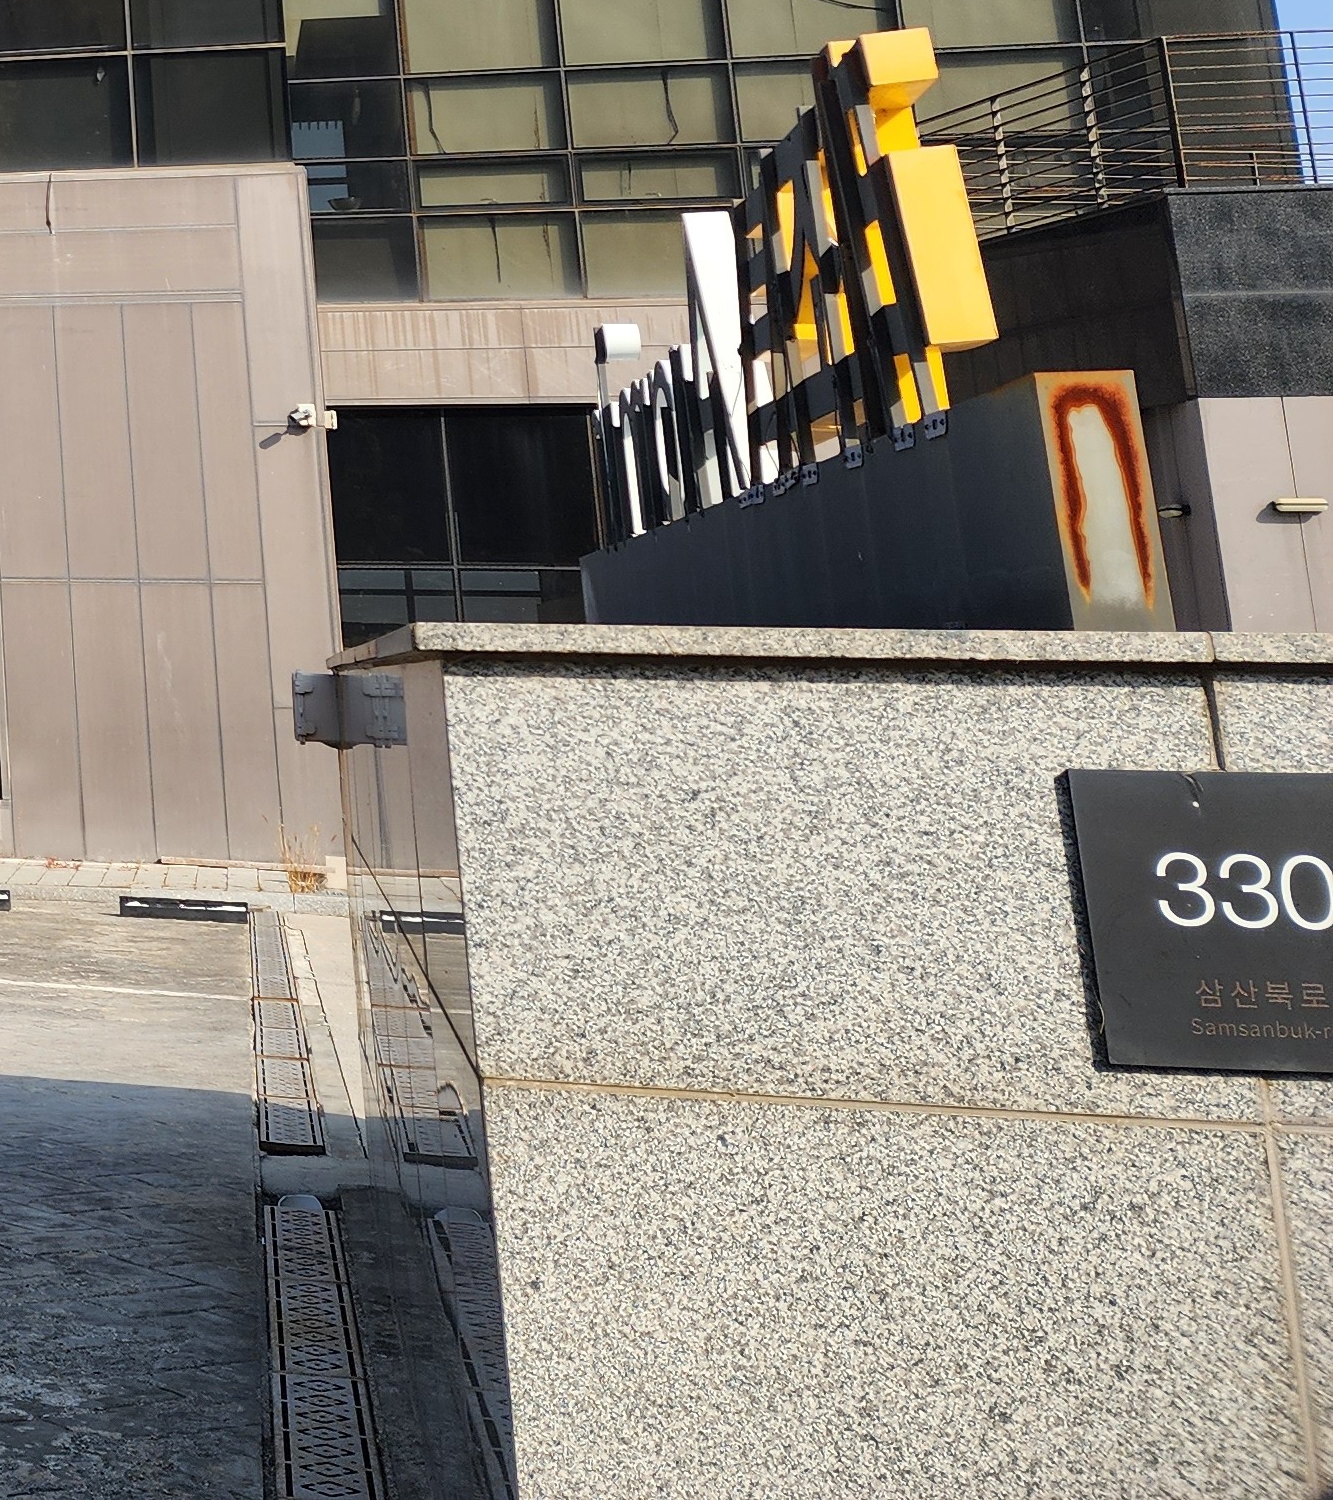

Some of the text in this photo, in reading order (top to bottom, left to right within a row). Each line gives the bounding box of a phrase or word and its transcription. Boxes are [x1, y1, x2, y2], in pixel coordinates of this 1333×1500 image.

[1156, 851, 1333, 931] 330
[1195, 979, 1330, 1010] 삼산북로
[1191, 1017, 1333, 1040] Samsanbuk-r
